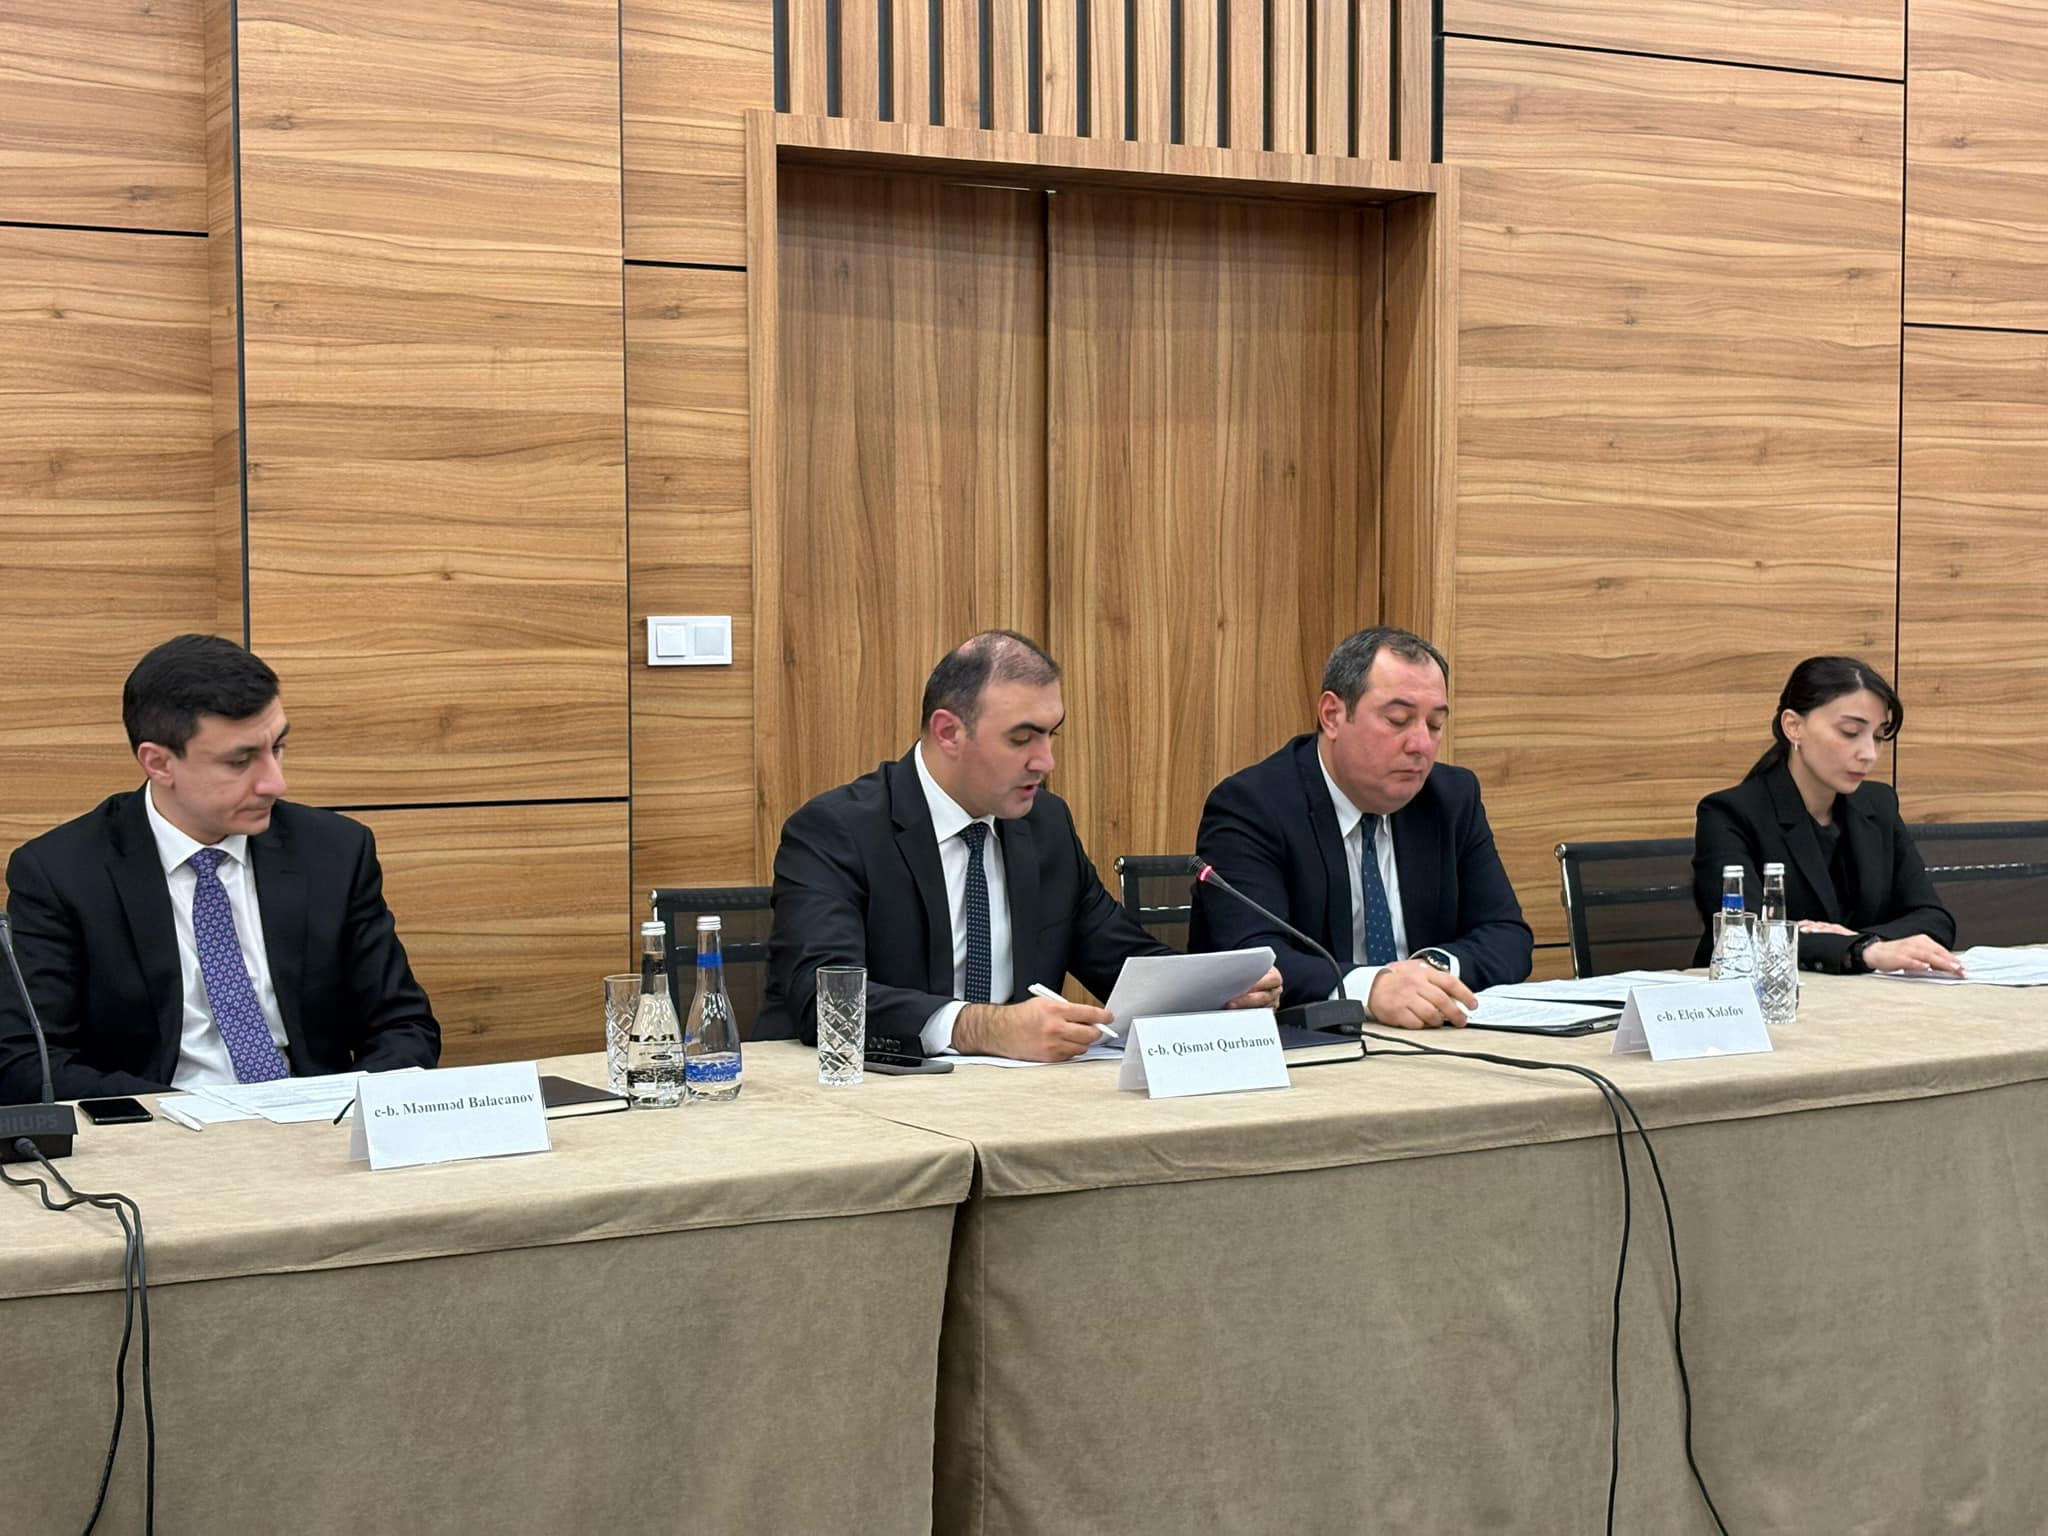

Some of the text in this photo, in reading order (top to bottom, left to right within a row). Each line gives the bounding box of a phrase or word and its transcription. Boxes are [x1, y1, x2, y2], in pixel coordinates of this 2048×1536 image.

[1678, 1008, 1704, 1022] Elçin
[1148, 1037, 1275, 1057] c-b. Qismət Qurbanov
[374, 1093, 534, 1118] c-b. Məmməd Balacanov
